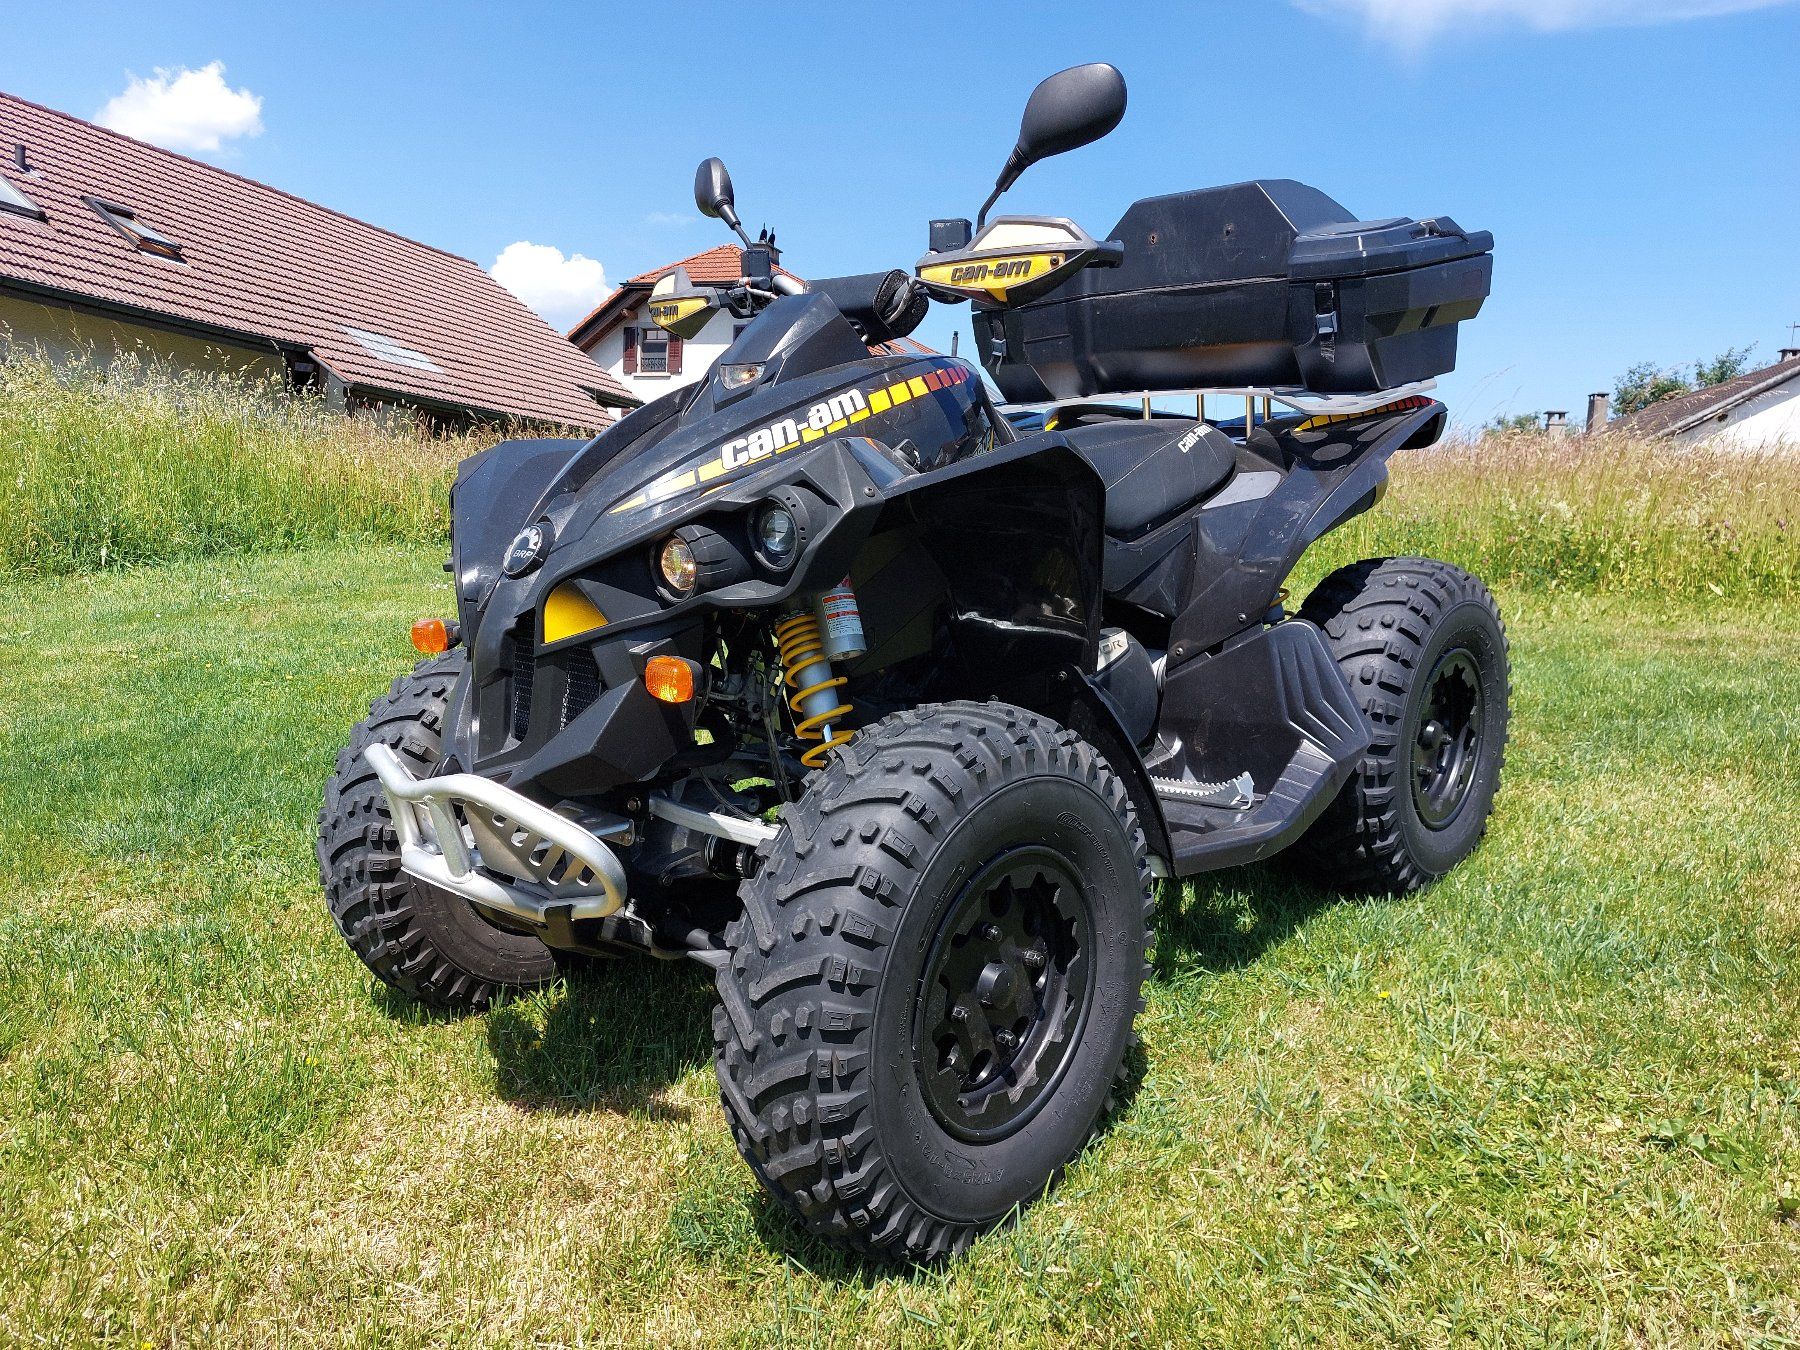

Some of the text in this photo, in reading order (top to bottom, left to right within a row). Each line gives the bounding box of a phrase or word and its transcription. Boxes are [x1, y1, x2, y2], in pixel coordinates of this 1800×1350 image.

[950, 259, 1032, 283] can-am
[721, 388, 867, 470] can-am
[1177, 424, 1213, 454] can-am
[512, 549, 533, 558] BRP
